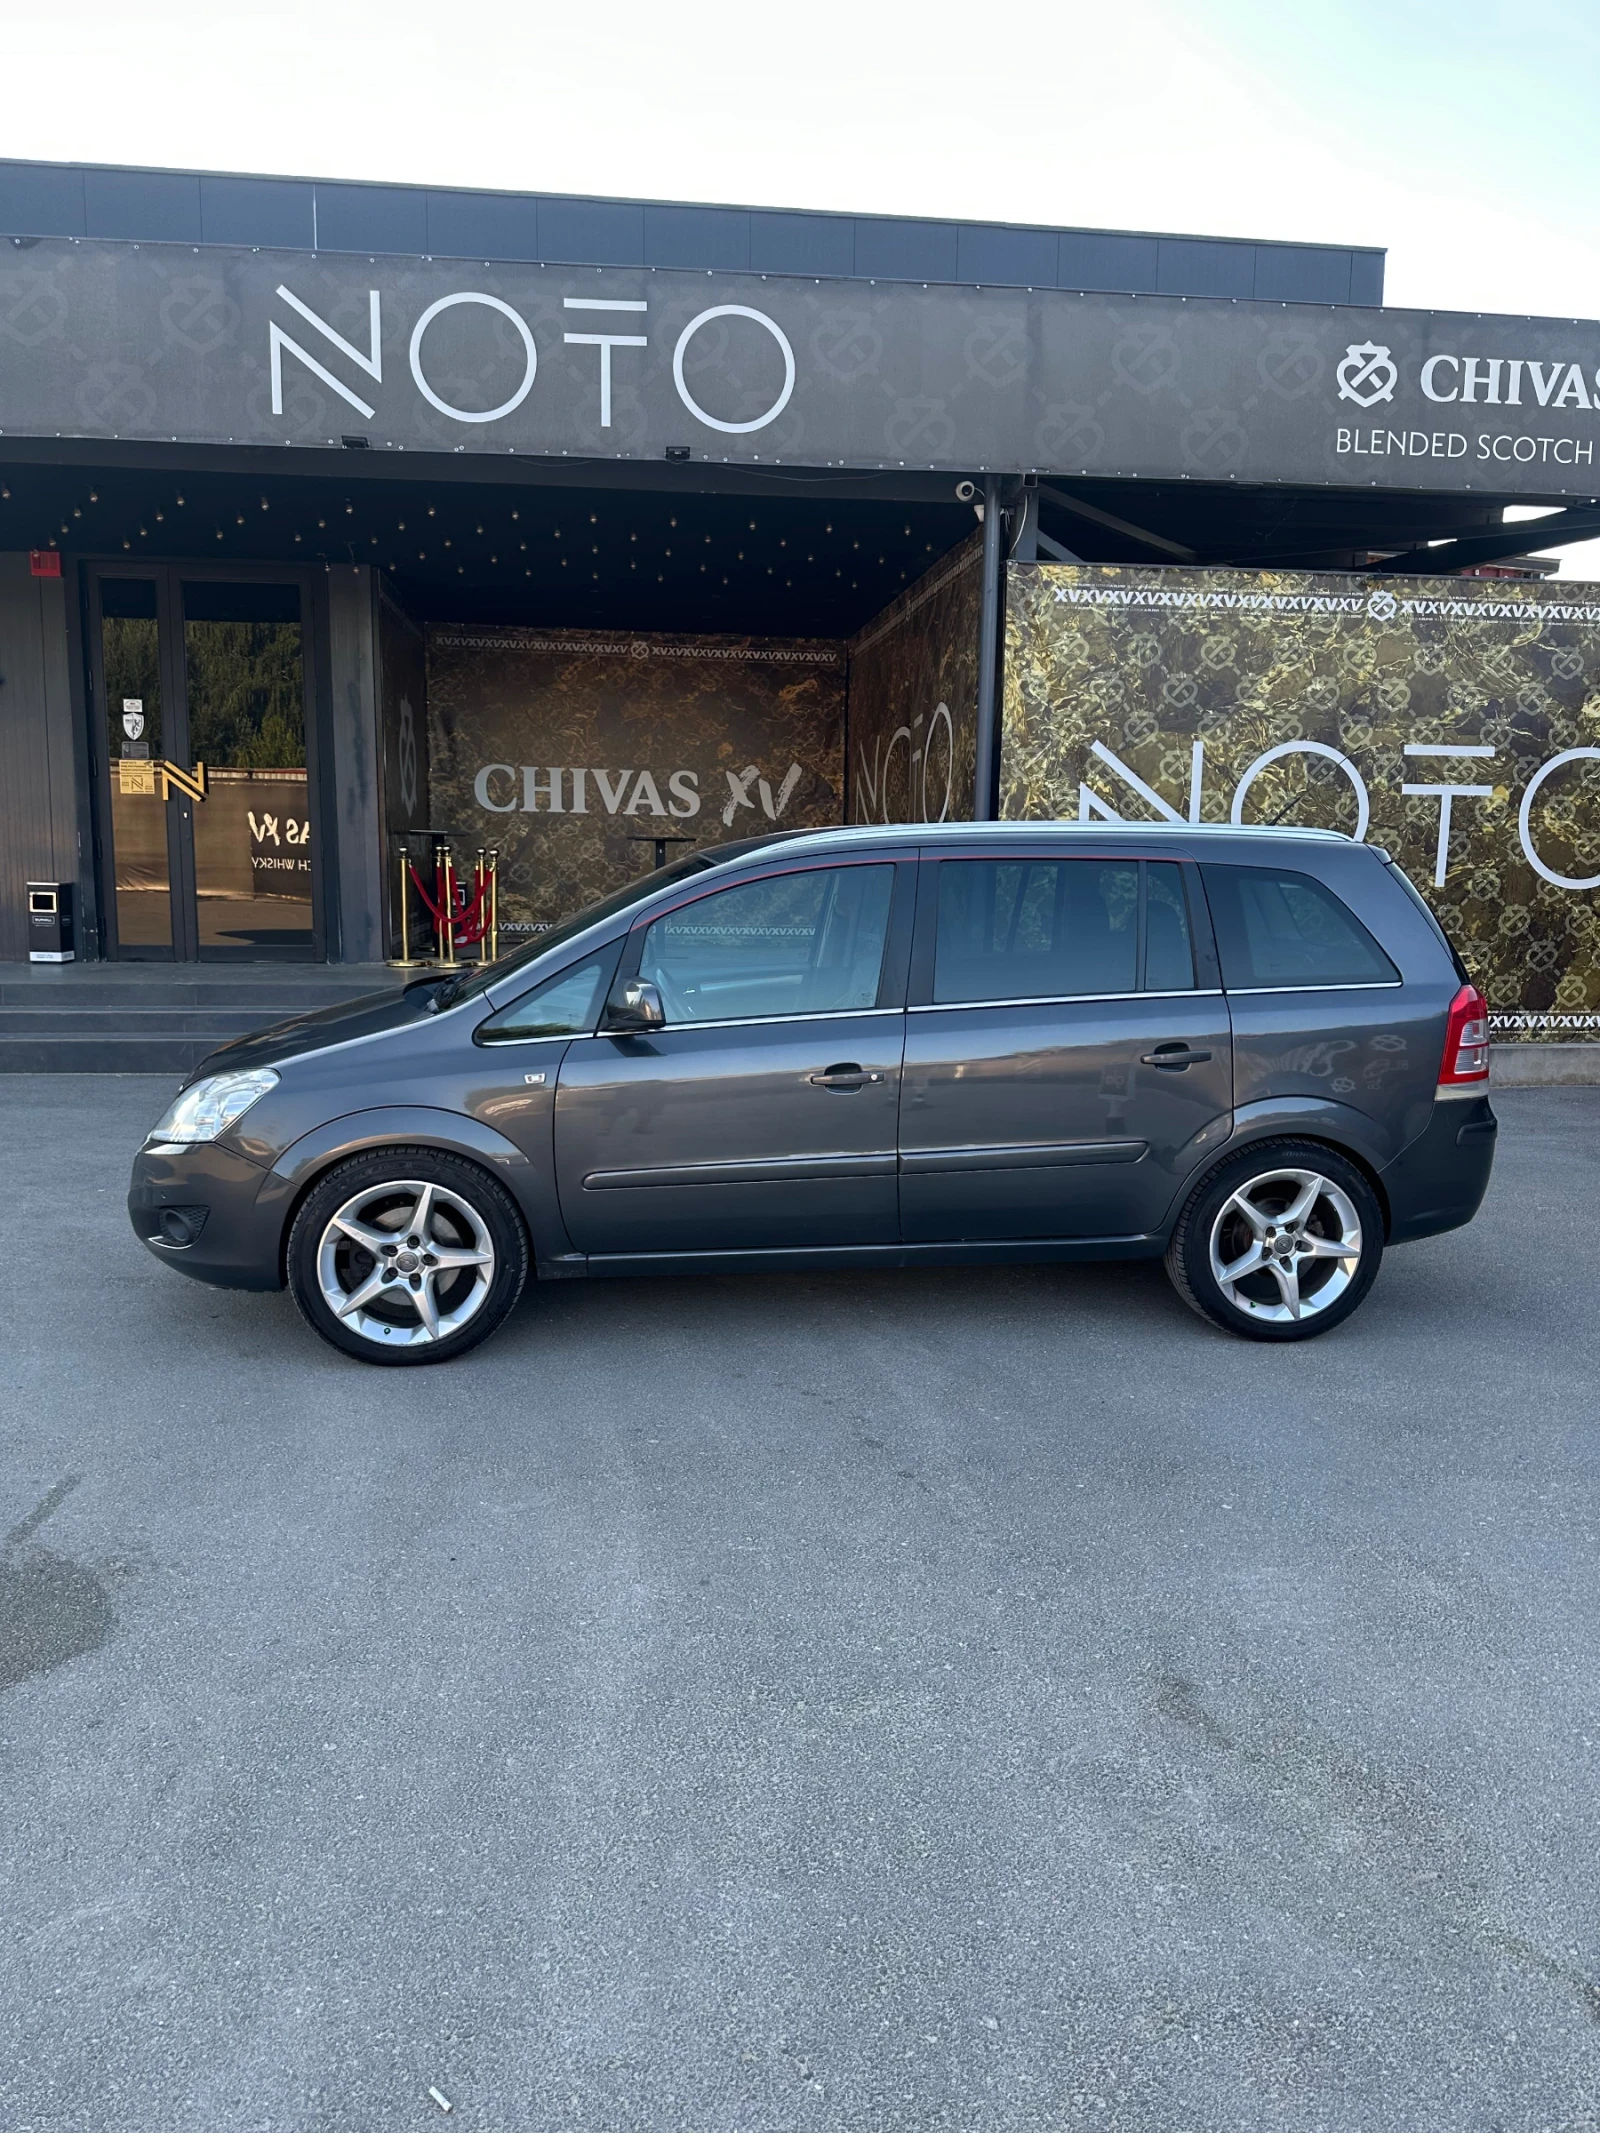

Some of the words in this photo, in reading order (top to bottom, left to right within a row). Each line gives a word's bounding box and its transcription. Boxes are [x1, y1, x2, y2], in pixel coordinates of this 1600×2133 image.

[270, 285, 796, 434] NOTO
[1420, 354, 1600, 410] CHIVA
[1336, 427, 1468, 458] BLENDED
[1476, 433, 1593, 465] SCOTCH
[474, 763, 701, 818] CHIVAS
[722, 762, 803, 827] XV
[1079, 740, 1600, 889] NOTO
